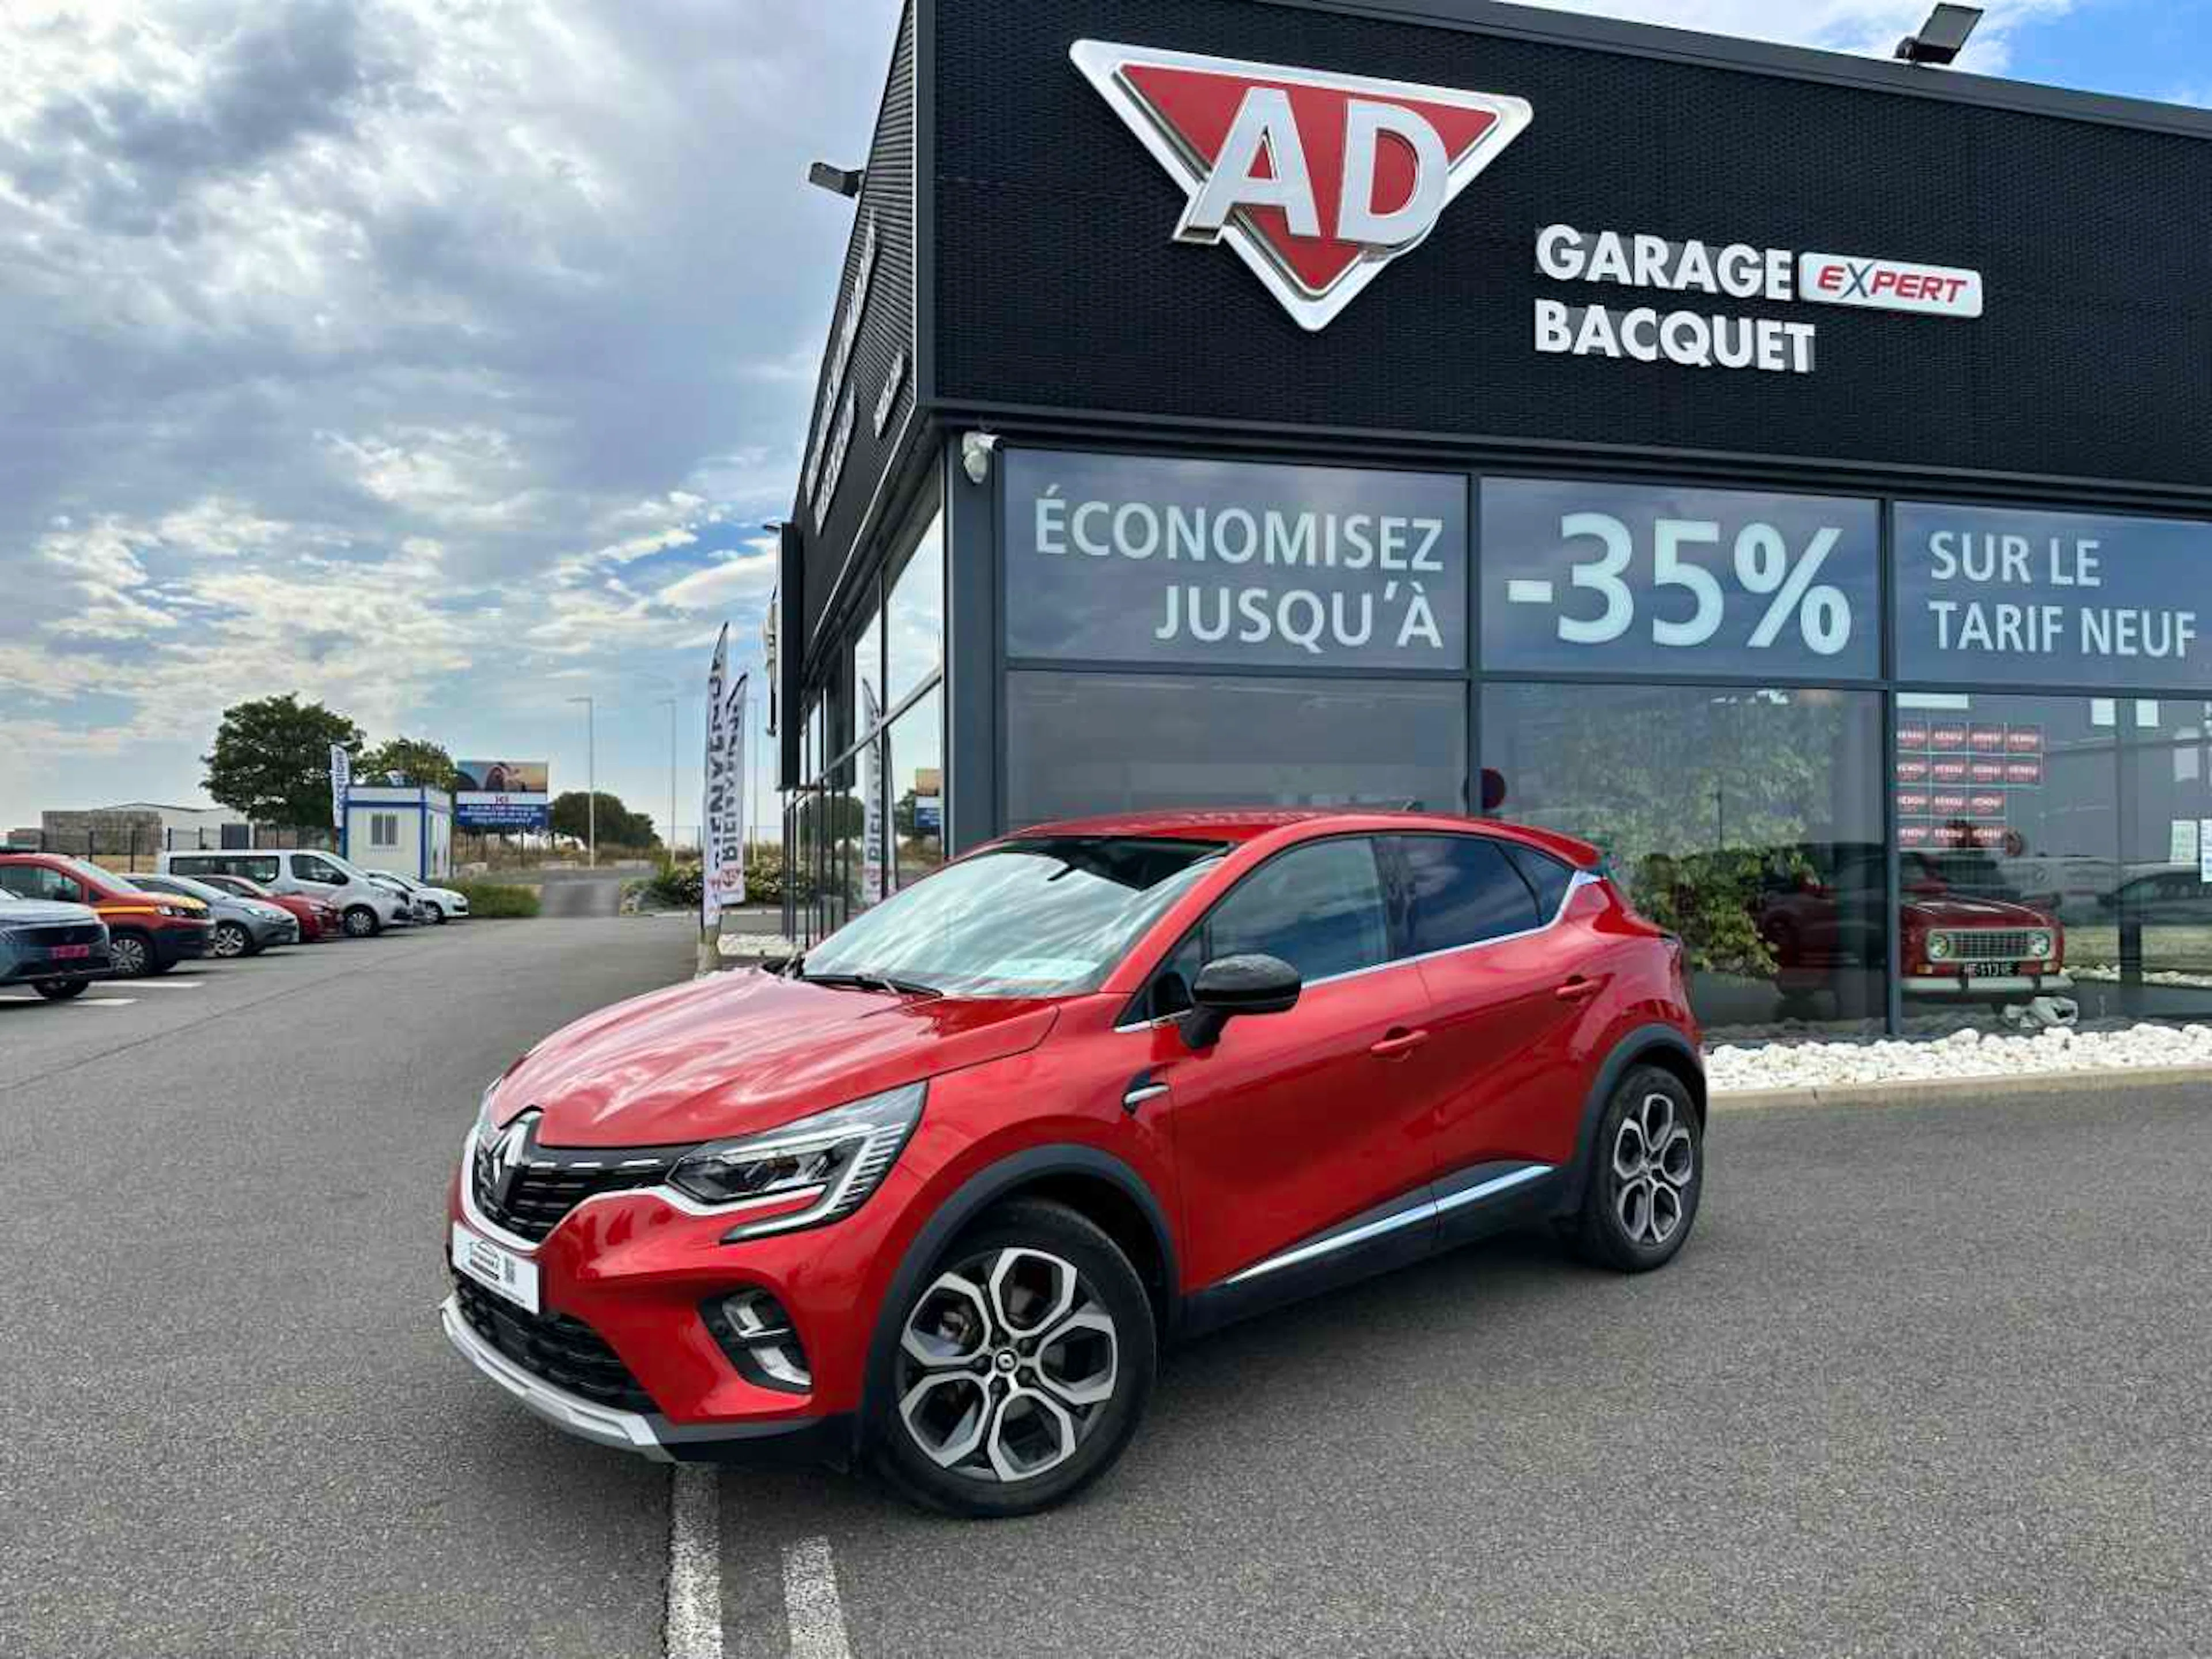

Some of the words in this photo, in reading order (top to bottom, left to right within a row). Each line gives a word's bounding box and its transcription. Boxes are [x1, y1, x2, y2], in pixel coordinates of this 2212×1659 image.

[1182, 86, 1448, 244] AD
[1535, 223, 1793, 301] GARAGE
[1533, 298, 1816, 373] BACQUET
[1035, 483, 1444, 571] ÉCONOMISEZ
[1929, 529, 2032, 584] SUR
[2049, 537, 2101, 588] LE
[1508, 512, 1851, 656] -35%
[1928, 600, 2065, 653] TARIF
[2080, 607, 2198, 658] NEUF
